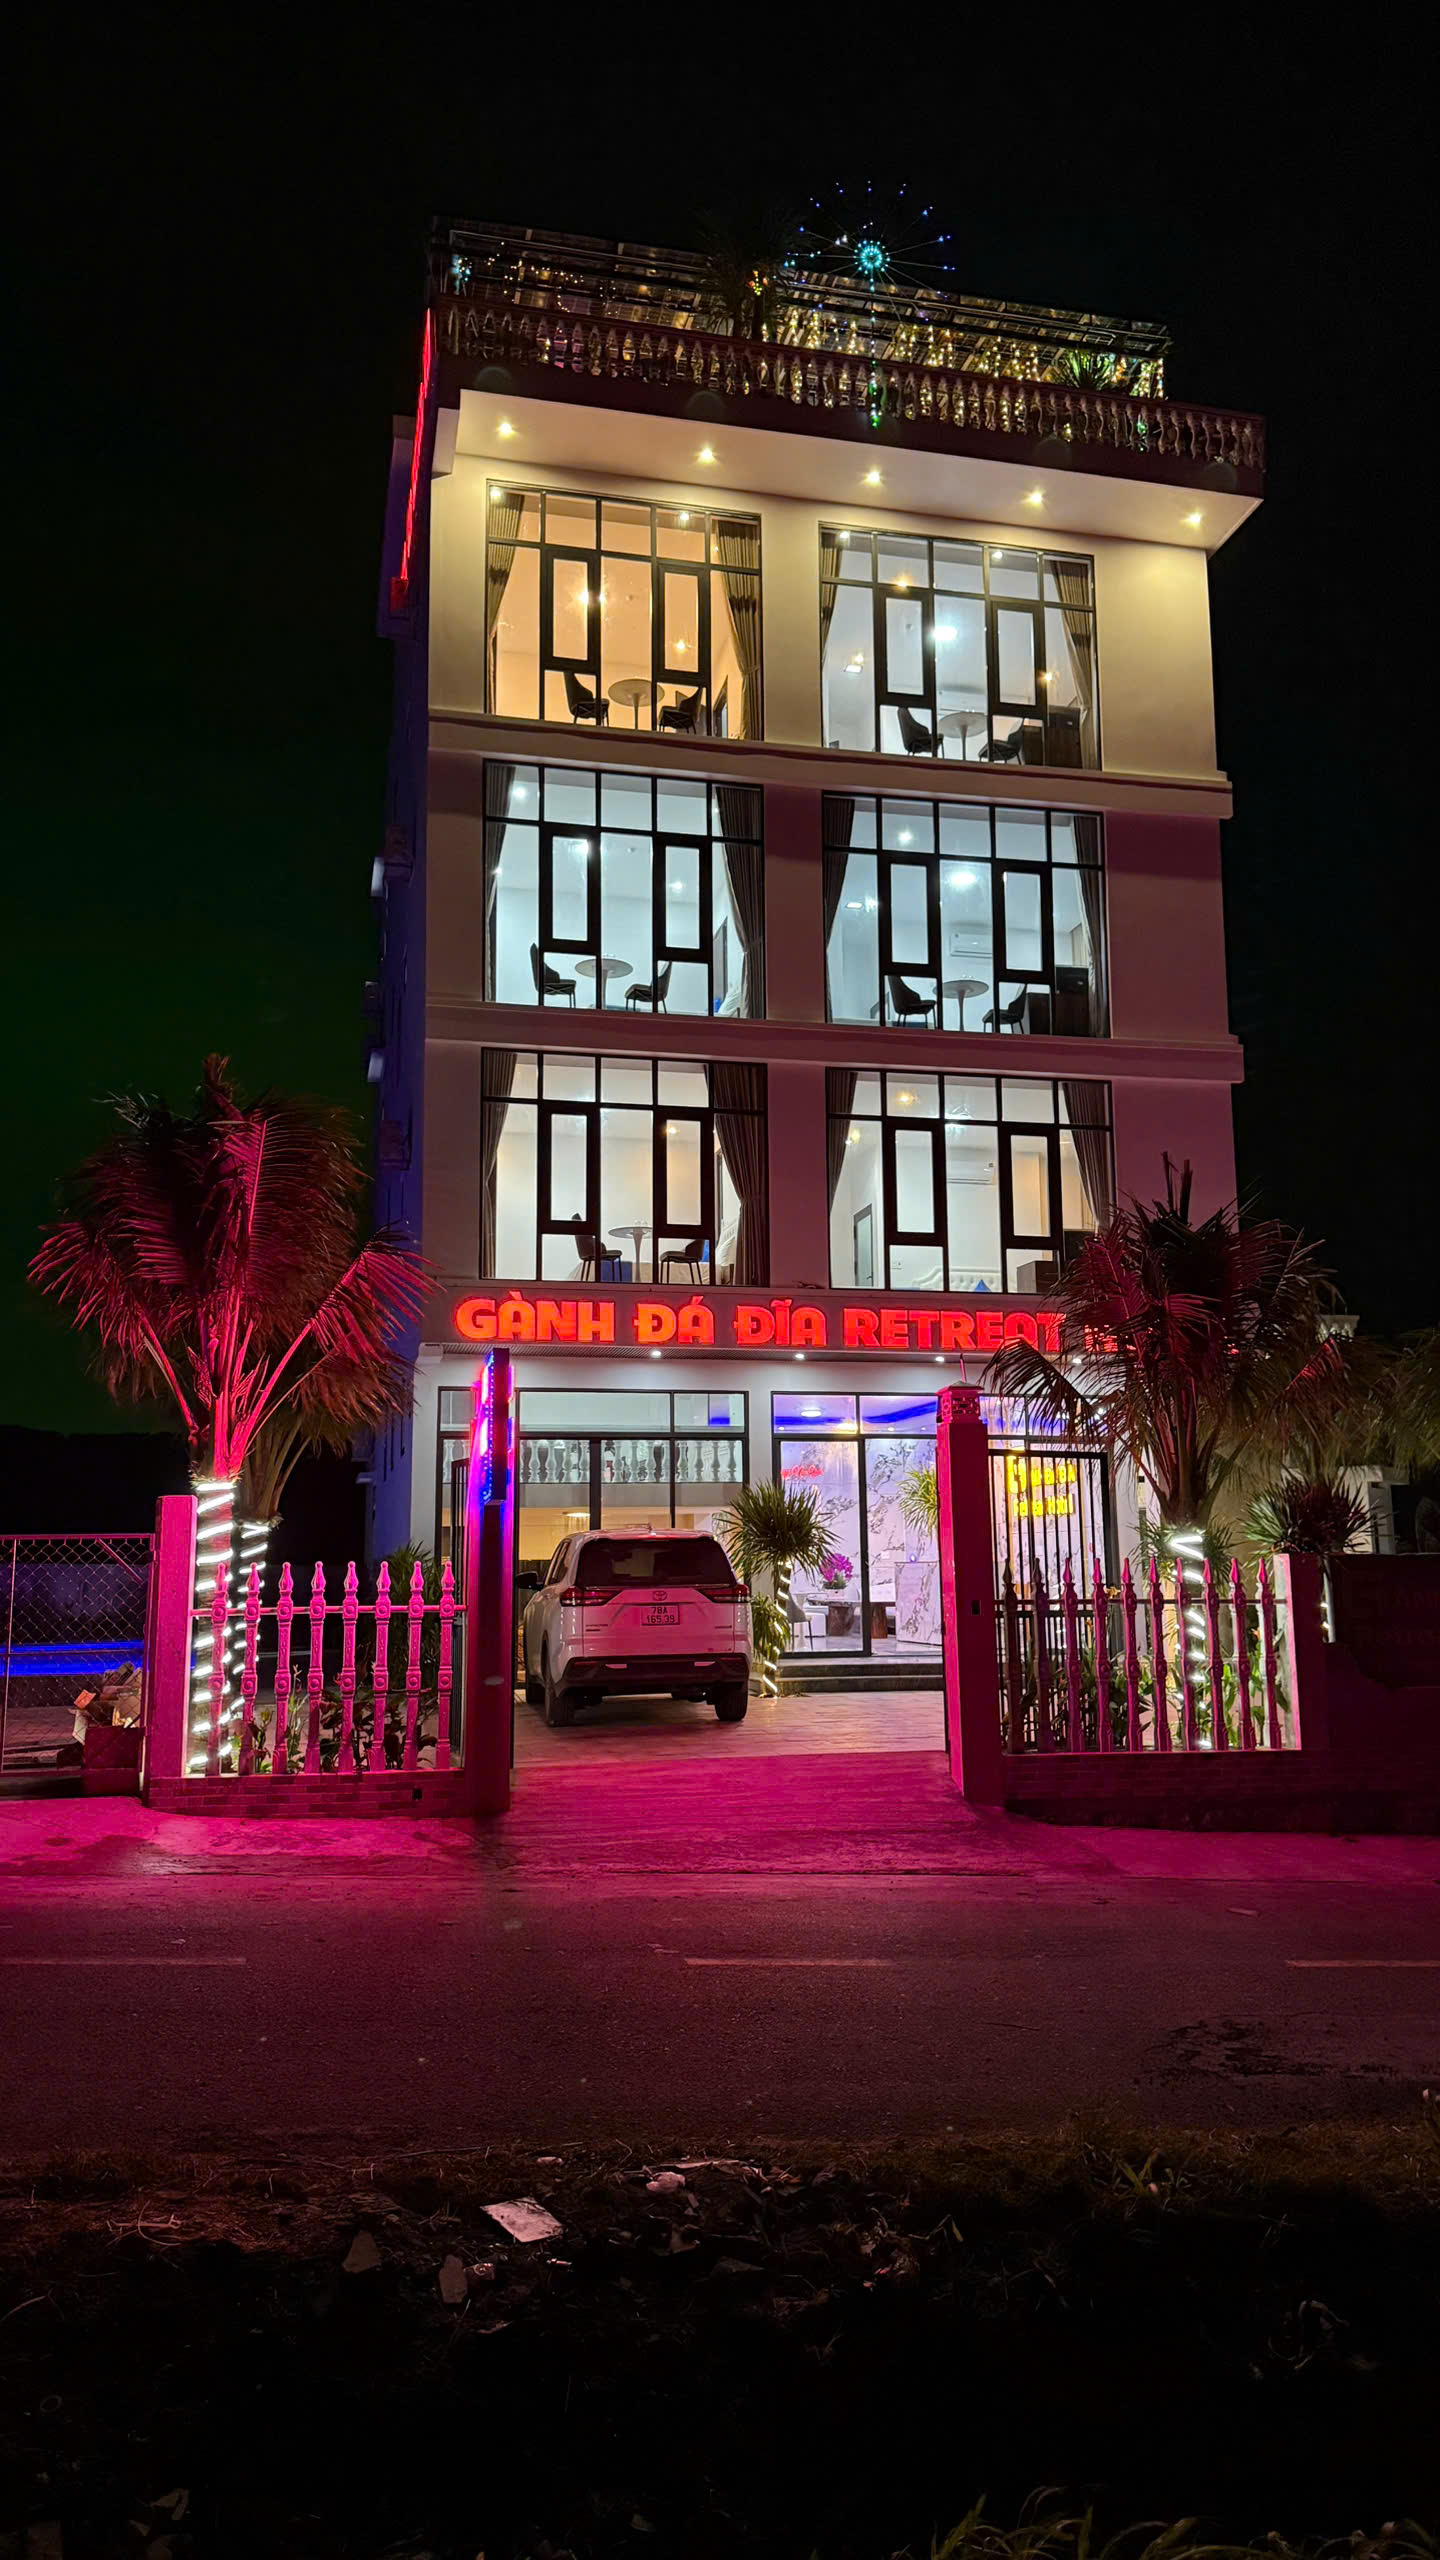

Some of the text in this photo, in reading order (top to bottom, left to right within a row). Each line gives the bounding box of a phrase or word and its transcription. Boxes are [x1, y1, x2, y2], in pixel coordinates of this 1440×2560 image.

[455, 1289, 615, 1343] GÀNH
[632, 1295, 715, 1345] ĐÁ
[732, 1298, 827, 1347] ĐĨA
[842, 1307, 1066, 1352] RETREAT
[651, 1606, 668, 1615] 78A
